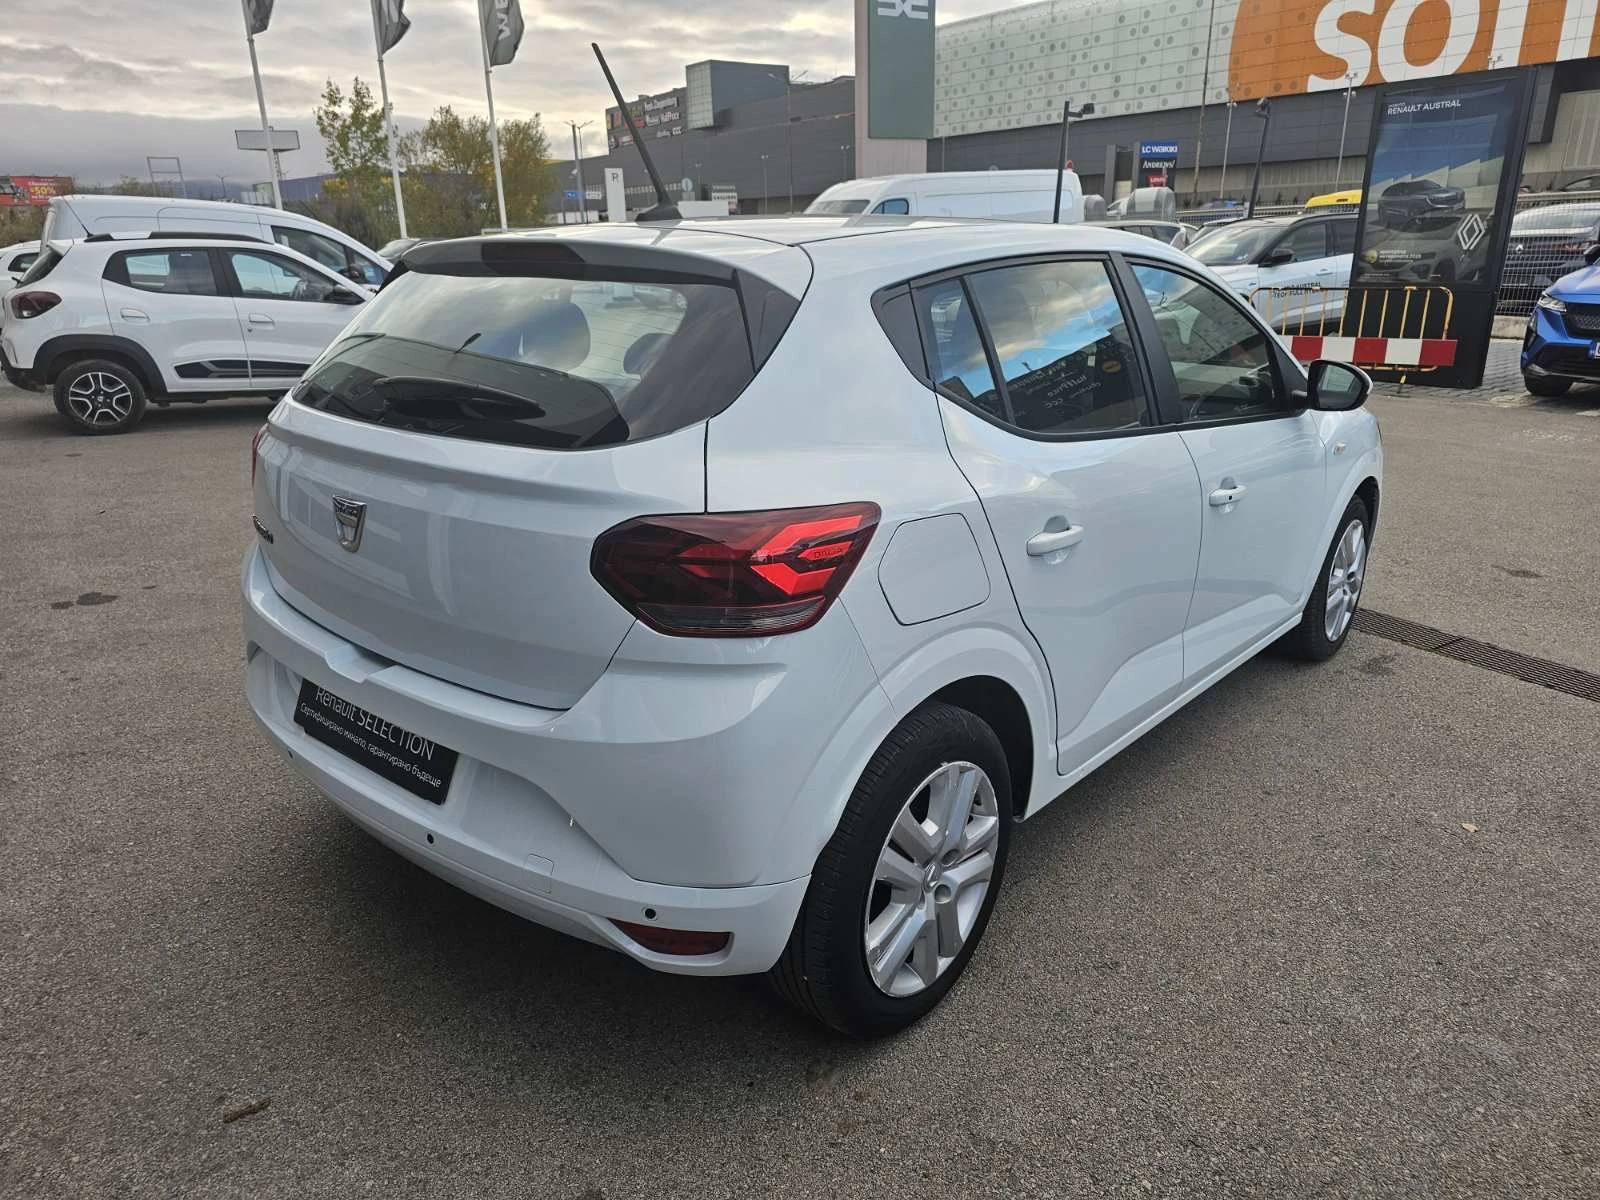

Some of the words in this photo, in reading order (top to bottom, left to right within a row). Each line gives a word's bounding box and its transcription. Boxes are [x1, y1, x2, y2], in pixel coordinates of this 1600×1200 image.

[1387, 104, 1422, 115] RENAULT
[1422, 99, 1461, 110] AUSTRAL
[300, 702, 344, 736] Сертифицирано
[344, 730, 367, 750] минало,
[367, 743, 412, 772] гарантирано
[411, 764, 442, 789] бъдеще
[316, 687, 356, 721] Renault
[357, 709, 435, 761] SELECTION
